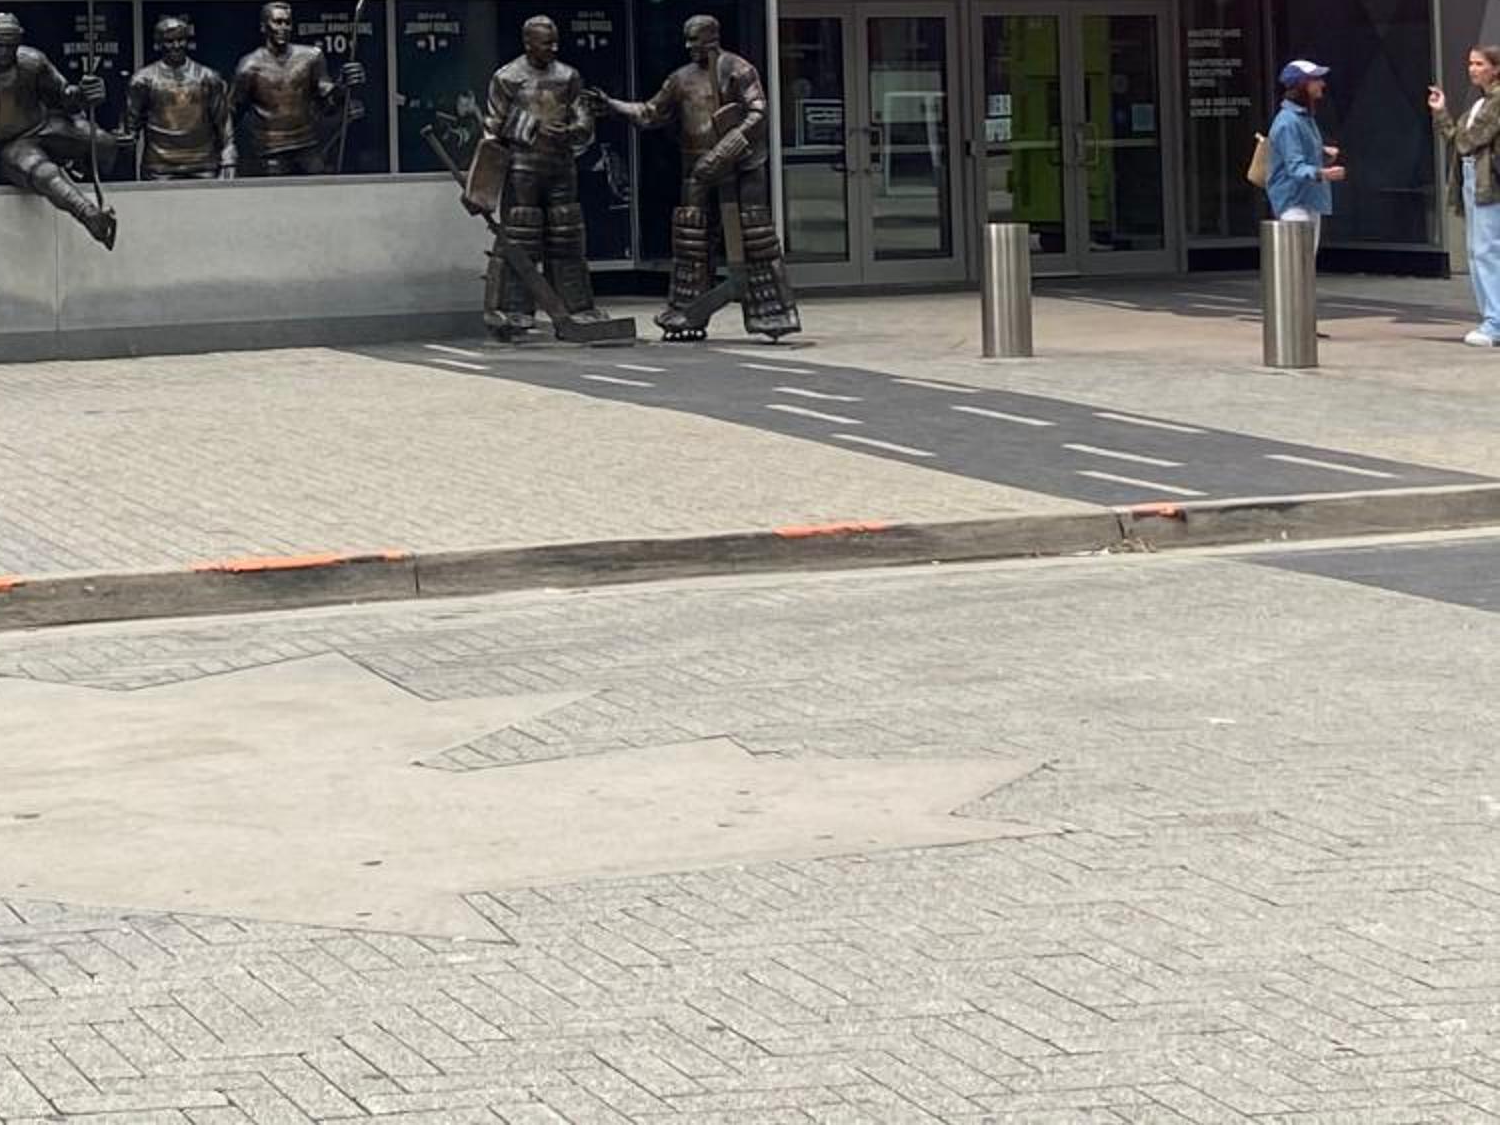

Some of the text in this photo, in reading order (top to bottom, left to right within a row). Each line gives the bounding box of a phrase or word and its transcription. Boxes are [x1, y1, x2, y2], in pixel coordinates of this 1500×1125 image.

[324, 34, 348, 53] 10
[428, 34, 437, 52] 1
[588, 33, 597, 51] 1
[80, 55, 102, 73] 17
